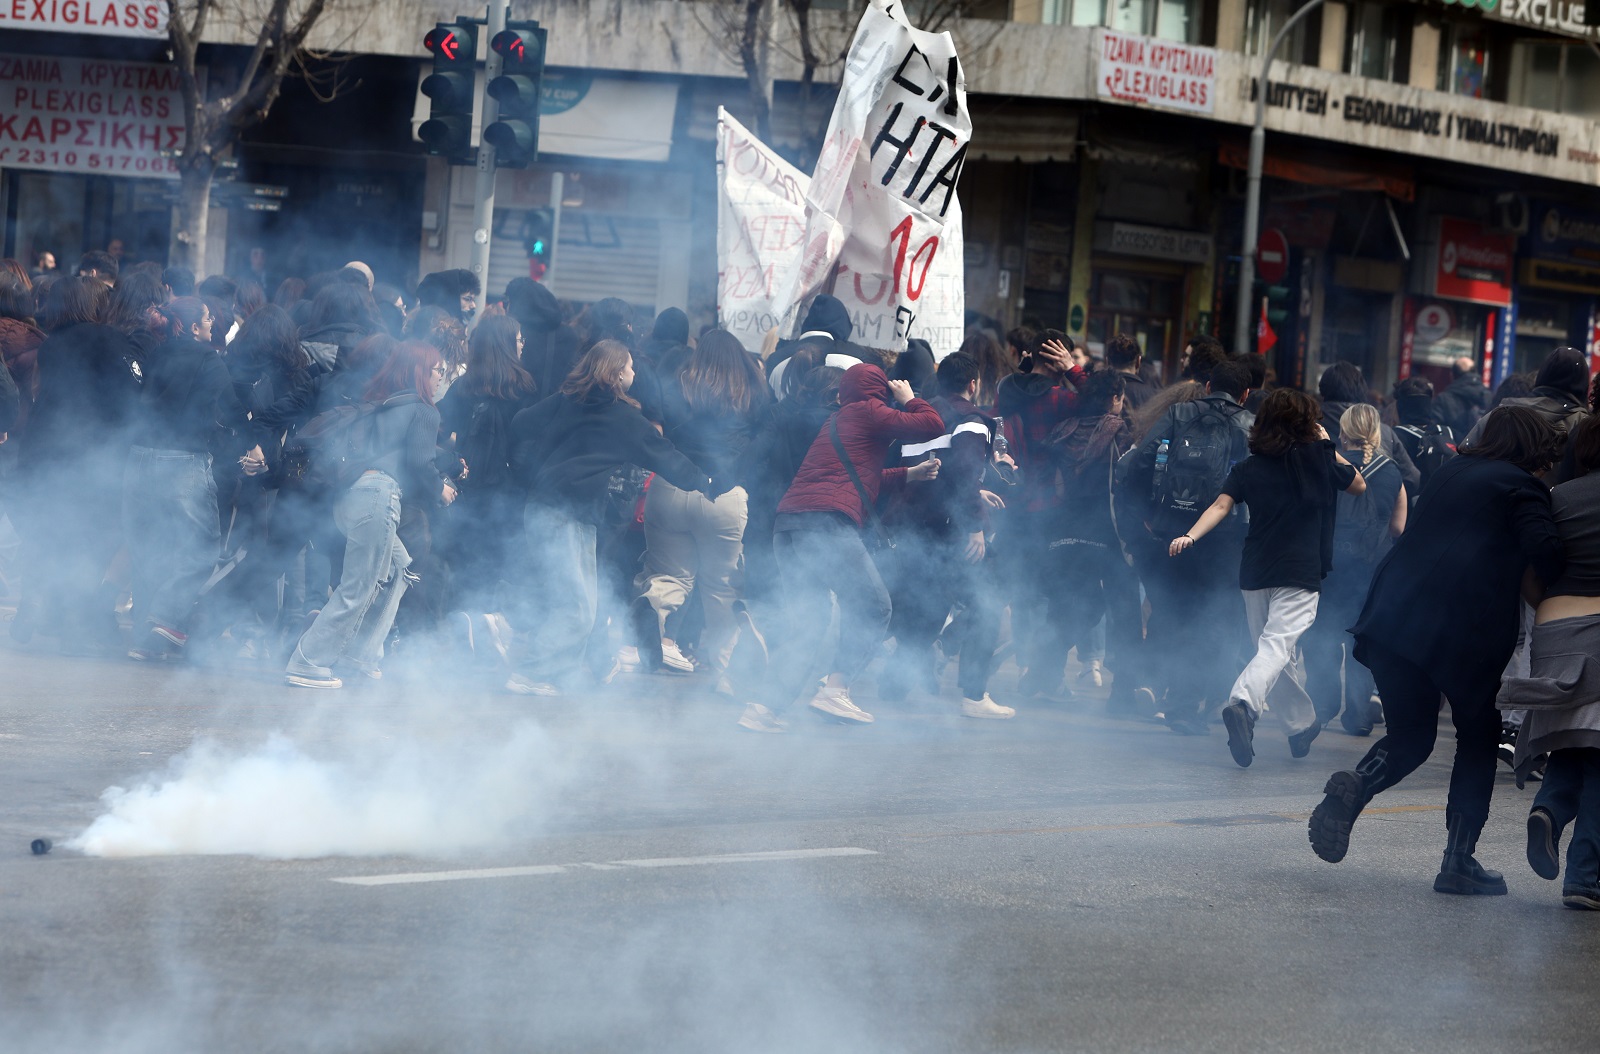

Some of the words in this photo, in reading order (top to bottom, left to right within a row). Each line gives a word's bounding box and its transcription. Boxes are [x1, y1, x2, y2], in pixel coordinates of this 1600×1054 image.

[15, 86, 171, 119] PLEXIGLASS
[1113, 67, 1208, 106] PLEXIGLASS
[17, 147, 78, 166] 2310
